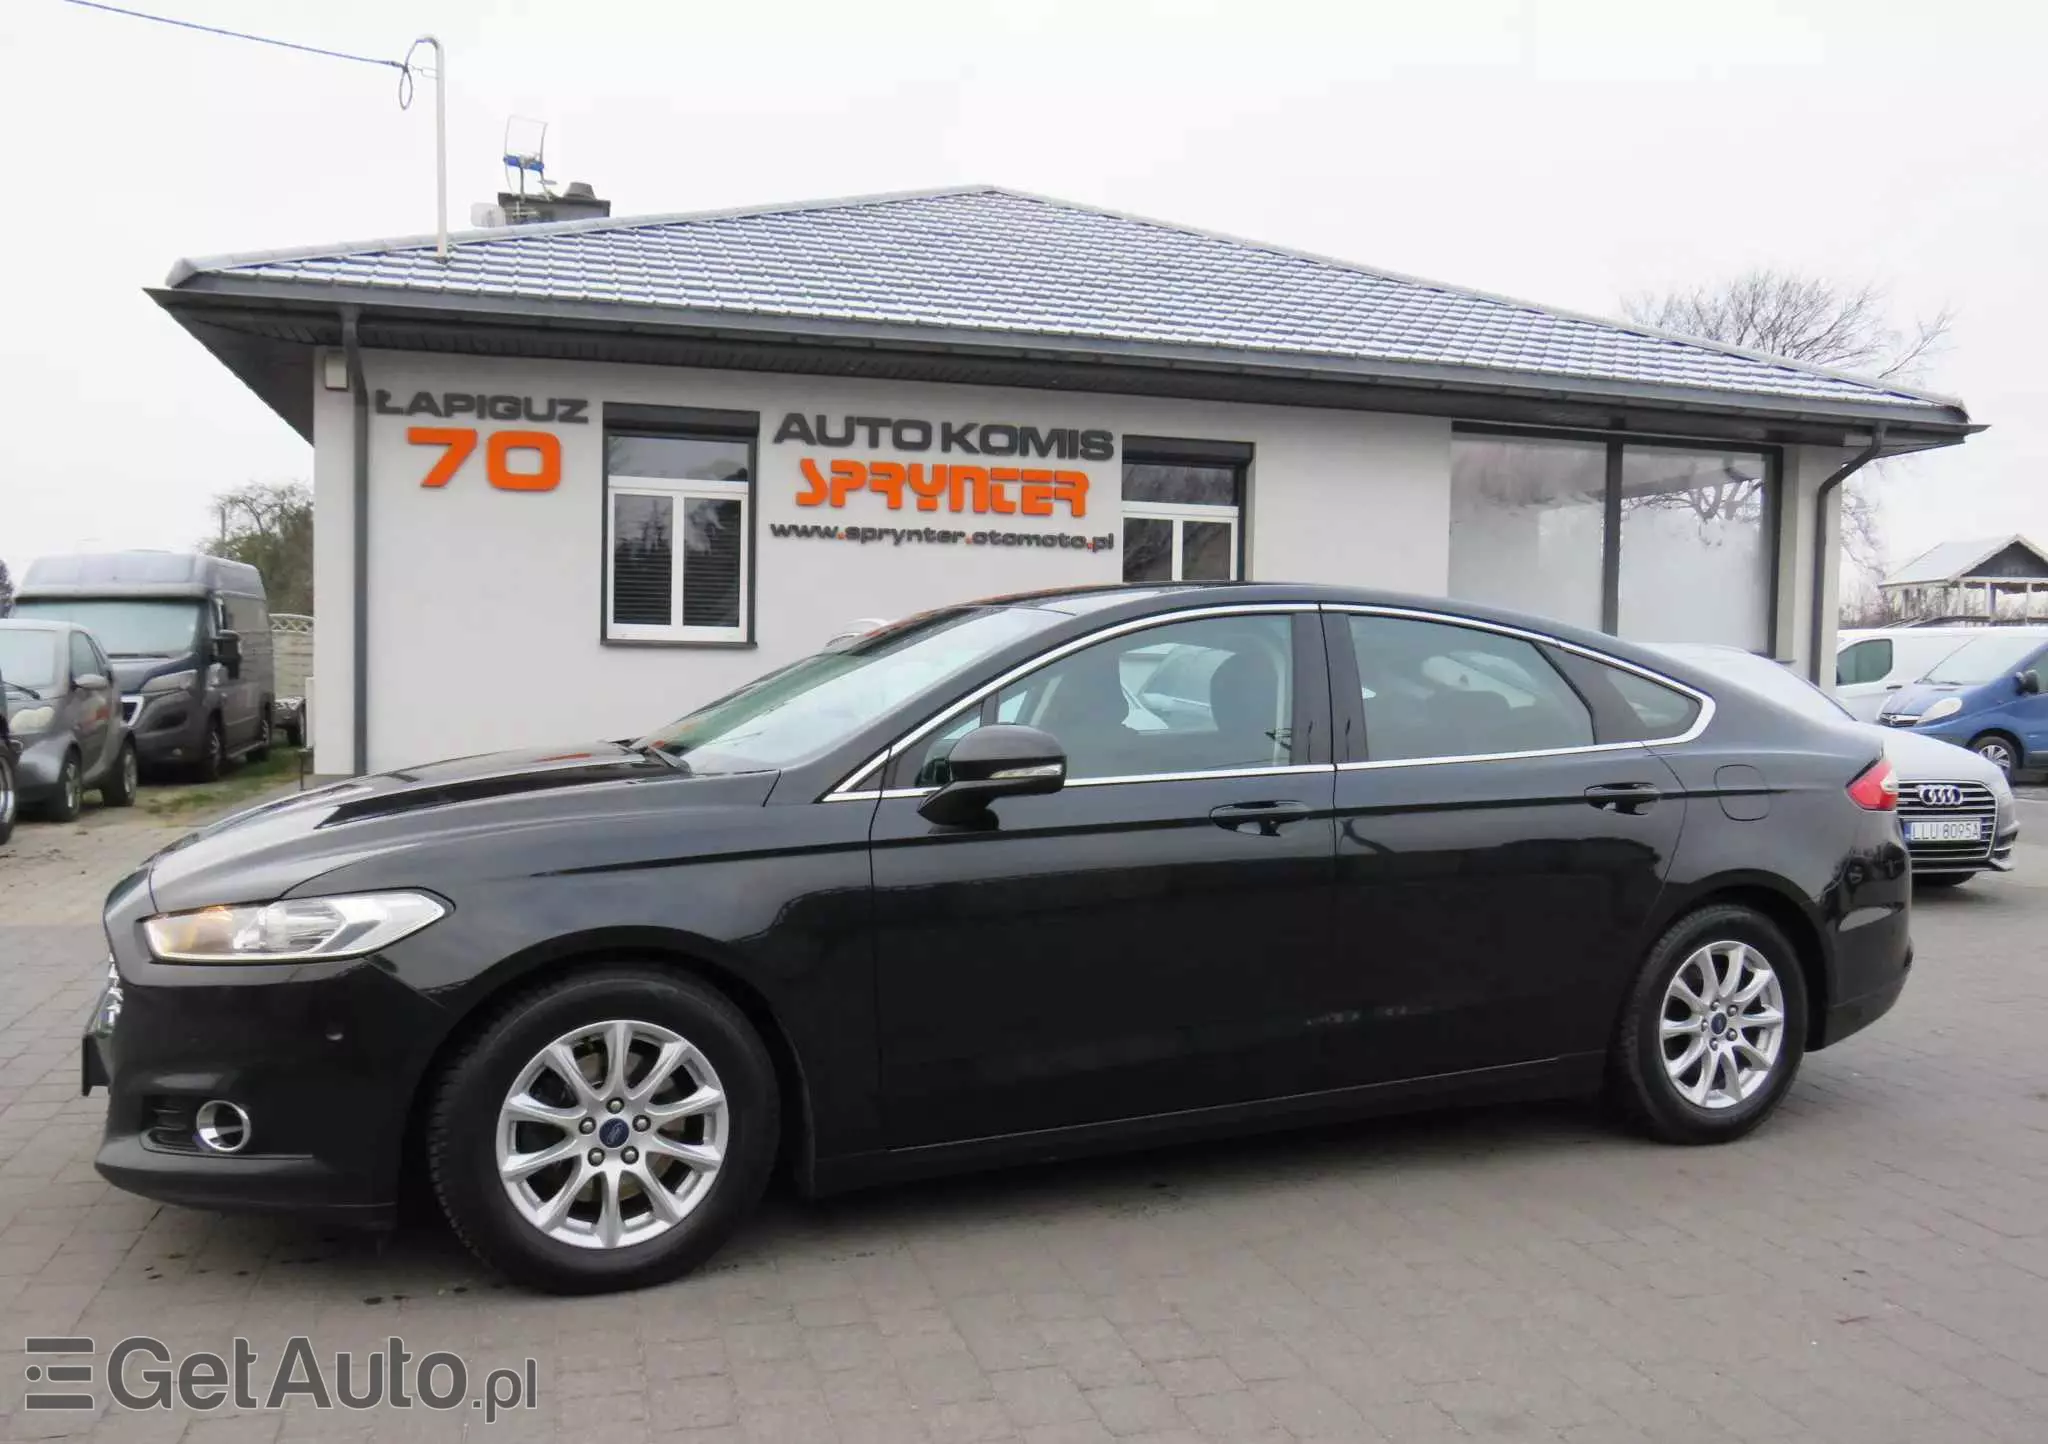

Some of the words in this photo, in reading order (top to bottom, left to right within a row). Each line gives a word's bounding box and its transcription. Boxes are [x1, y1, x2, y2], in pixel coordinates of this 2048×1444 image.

[407, 427, 562, 492] 70
[795, 458, 1090, 518] SPRYNTER
[770, 523, 1115, 552] www.sprynter.otomoto.pl
